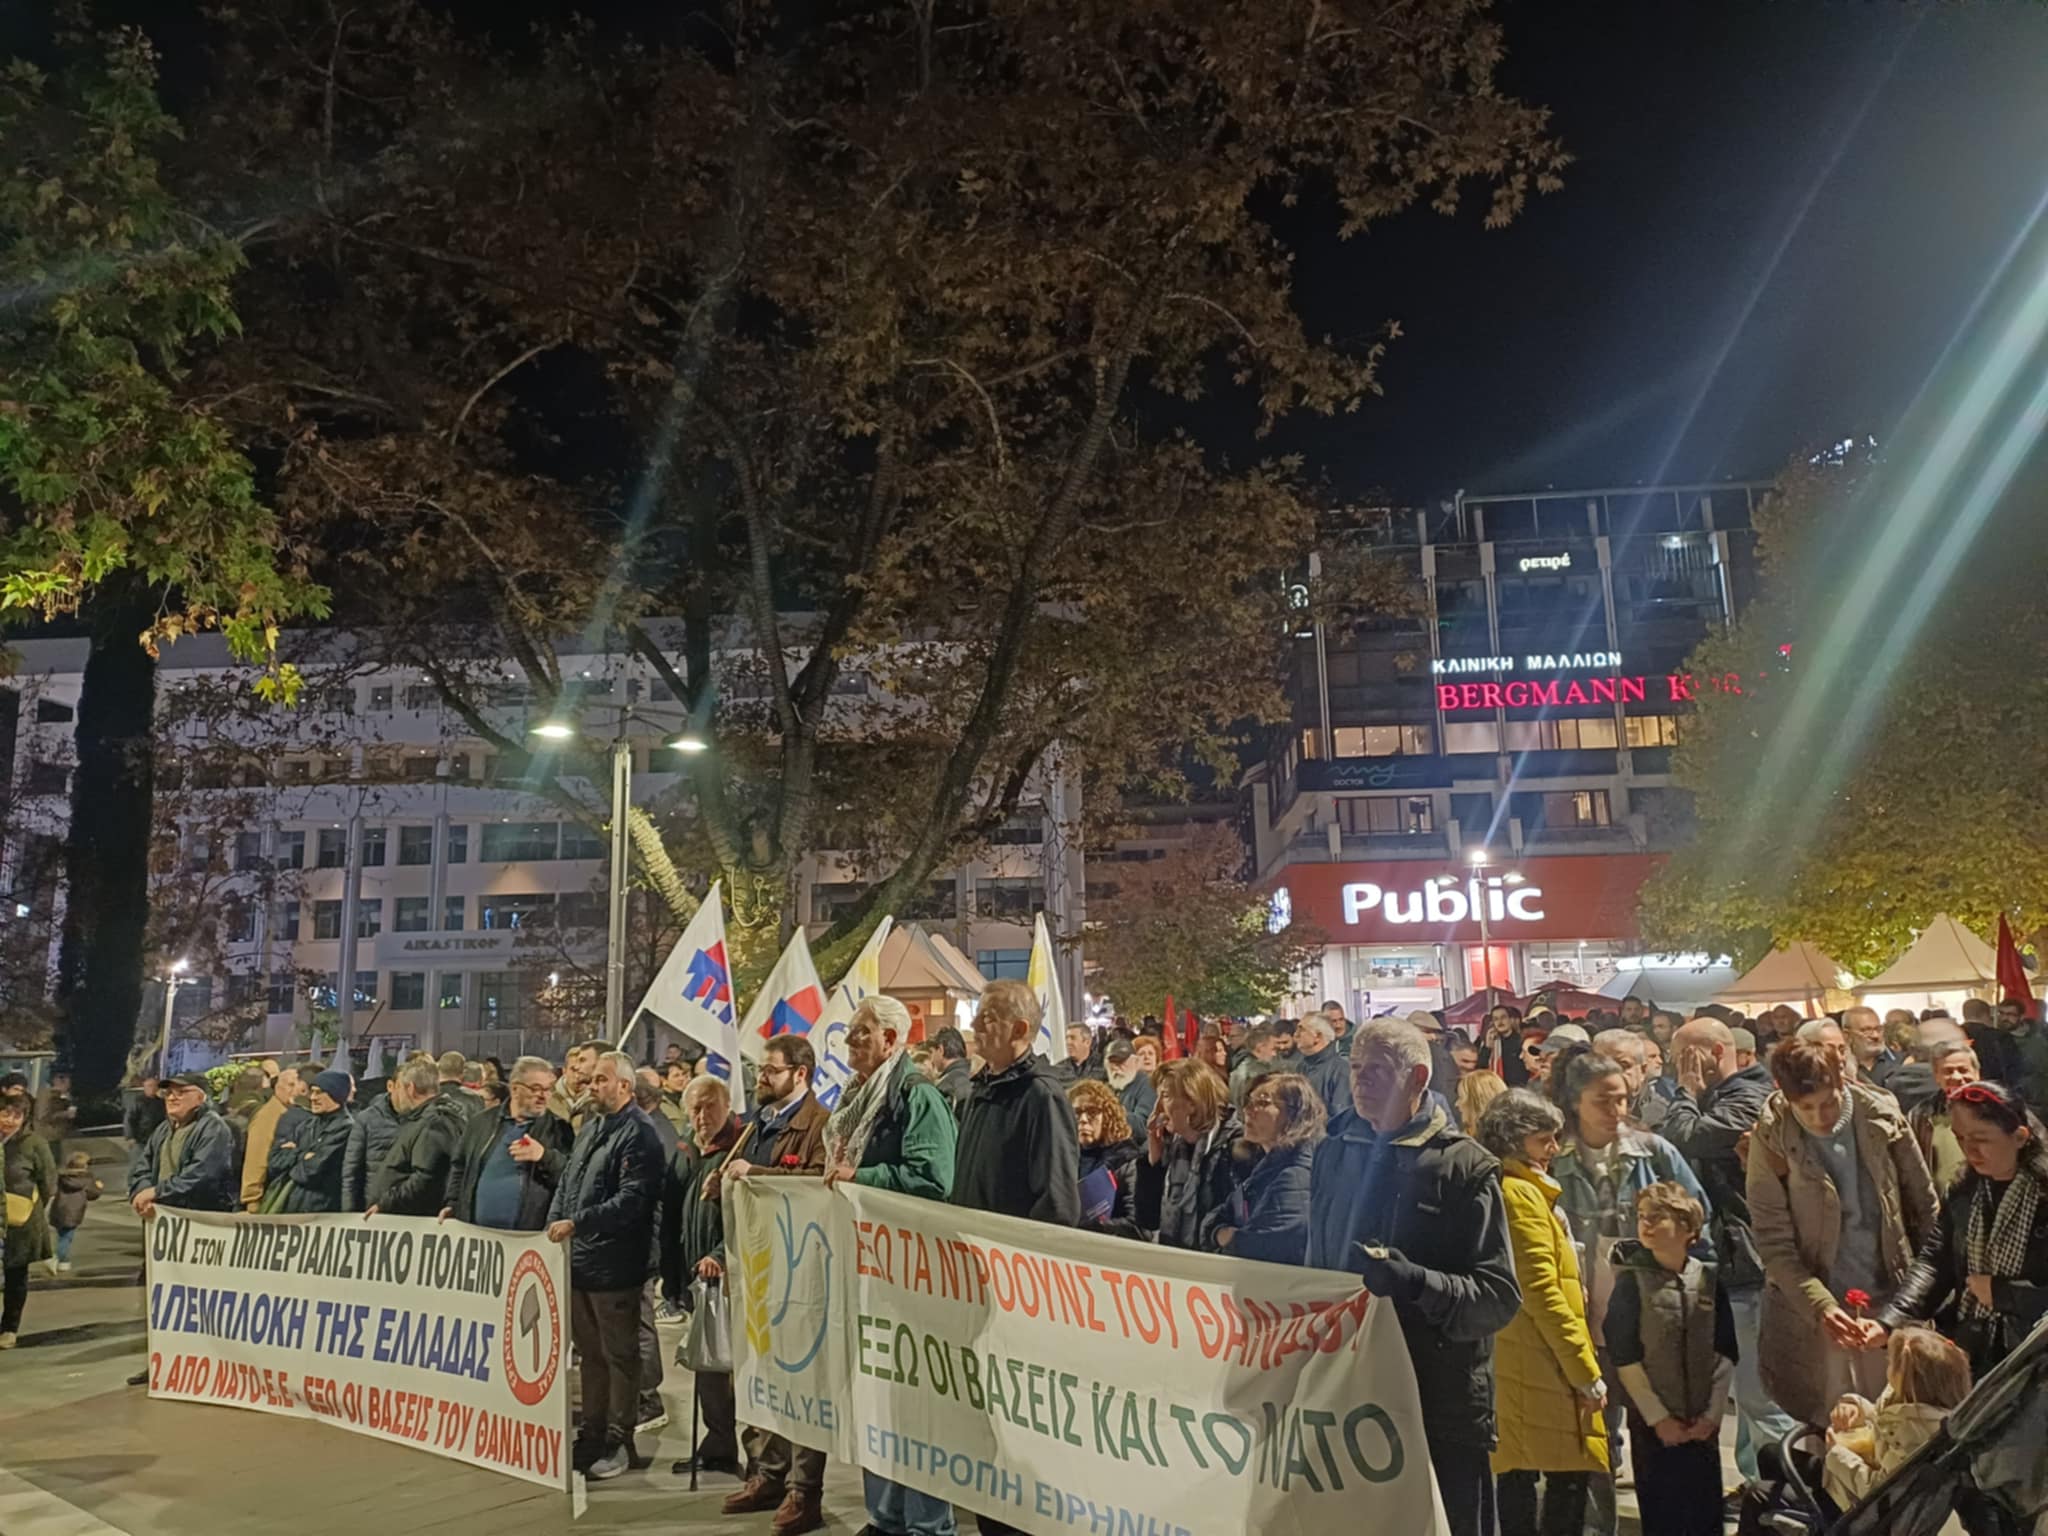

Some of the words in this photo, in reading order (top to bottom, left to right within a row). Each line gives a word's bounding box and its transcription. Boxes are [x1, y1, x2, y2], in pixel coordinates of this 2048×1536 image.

[1432, 656, 1513, 674] ΚΛΙΝΙΚΗ
[1527, 651, 1622, 671] ΜΑΛΛΙΩΝ
[1437, 676, 1647, 710] BERGMANN
[1343, 877, 1545, 925] Public
[153, 1215, 190, 1263] ΟΧΙ
[190, 1238, 227, 1267] ΣΤΟΝ
[229, 1221, 410, 1285] ΙΜΠΕΡΙΑΛΙΣΤΙΚΟ
[416, 1233, 505, 1298] ΠΟΛΕΜΟ
[852, 1220, 894, 1284] ΕΞΩ
[898, 1228, 932, 1296] ΤΑ
[935, 1237, 1106, 1333] ΝΤΡΟΟΥΝΣ
[1102, 1270, 1178, 1348] ΤΟΥ
[315, 1300, 369, 1358] ΤΗΣ
[373, 1308, 495, 1382] ΕΛΛΑΔΑΣ
[164, 1354, 209, 1394] ΑΠΟ
[304, 1375, 342, 1419] ΕΞΩ
[342, 1382, 364, 1425] ΟΙ
[369, 1387, 433, 1442] ΒΑΣΕΙΣ
[435, 1400, 475, 1451] ΤΟΥ
[475, 1416, 562, 1478] ΘΑΝΑΤΟΥ
[858, 1314, 919, 1387] ΕΞΩ
[923, 1334, 961, 1402] ΟΙ
[963, 1347, 1082, 1448] ΒΑΣΕΙΣ
[1092, 1381, 1169, 1467] ΚΑΙ
[1171, 1404, 1251, 1476] ΤΟ
[1259, 1401, 1405, 1494] ΝΑΤΟ
[866, 1423, 1024, 1507] ΕΠΙΤΡΟΠΗ
